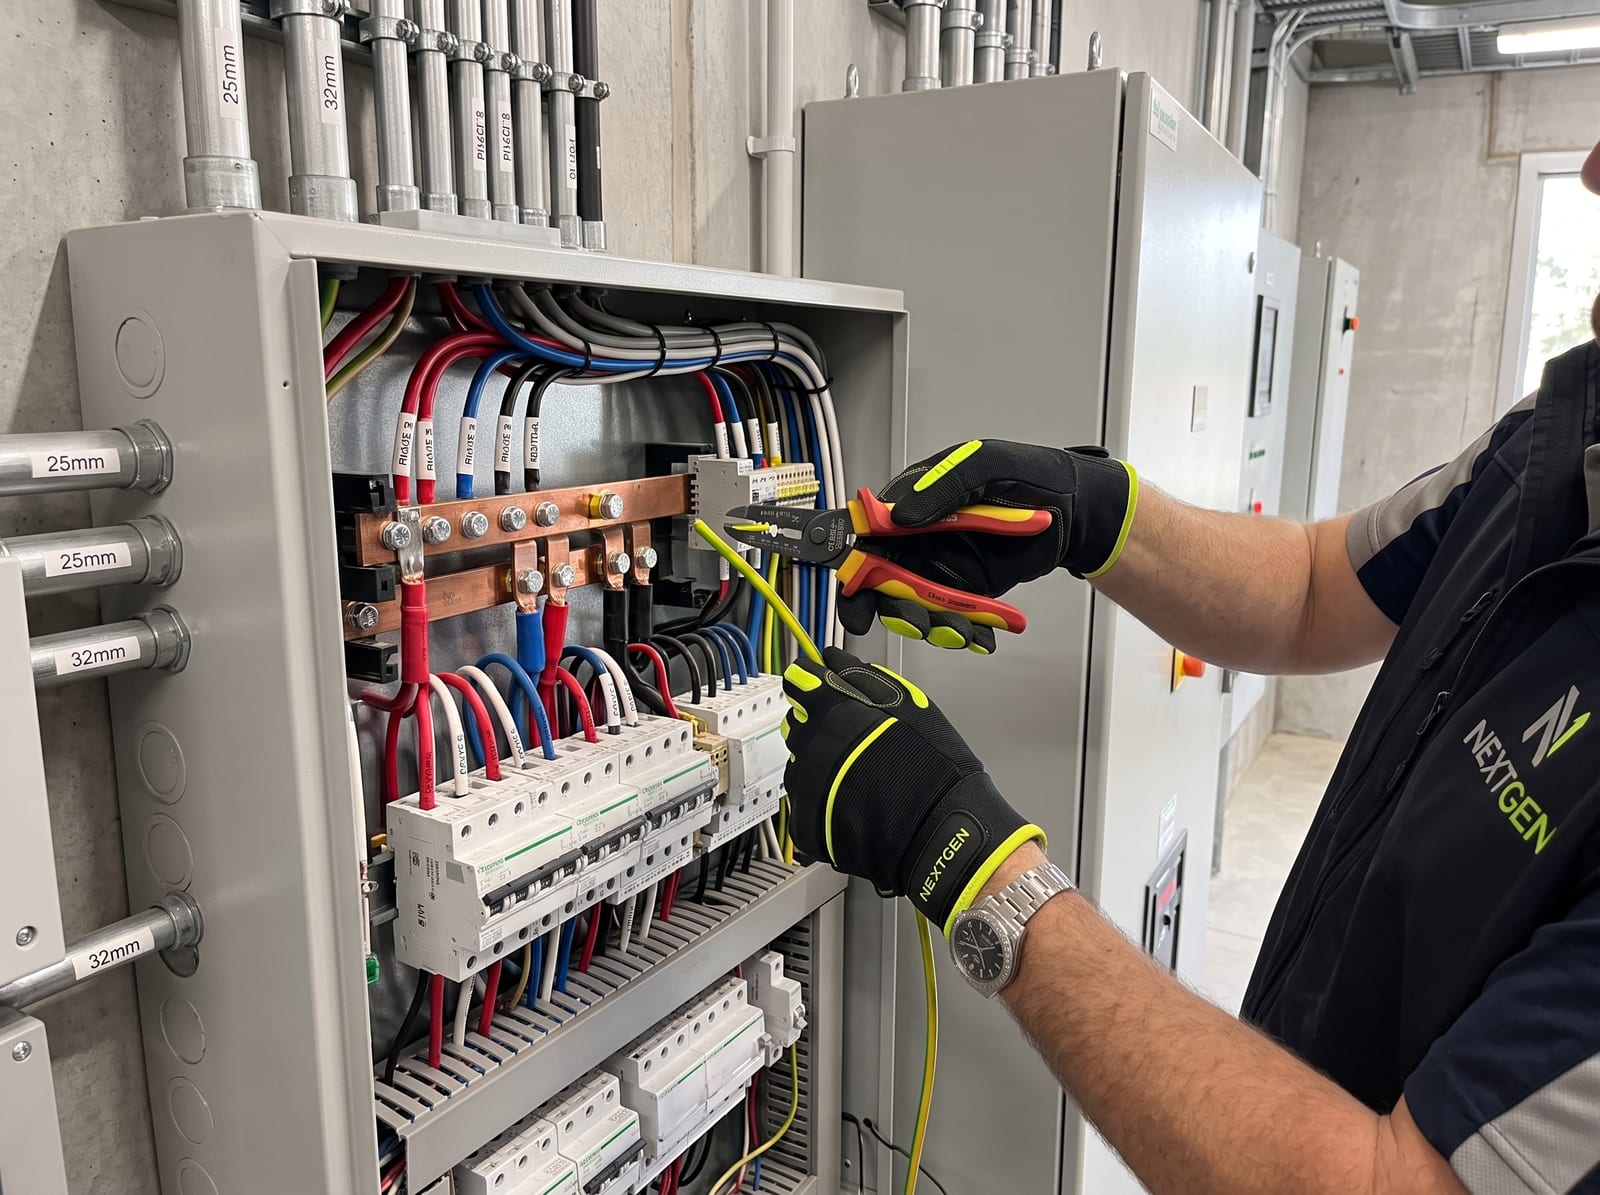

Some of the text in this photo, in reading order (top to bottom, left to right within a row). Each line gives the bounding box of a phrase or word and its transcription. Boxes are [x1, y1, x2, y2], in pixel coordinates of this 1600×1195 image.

[222, 45, 238, 105] 25mm
[323, 55, 338, 110] 32mm
[47, 455, 105, 473] 25mm
[60, 551, 117, 570] 25mm
[71, 645, 126, 667] 32mm
[1463, 719, 1558, 855] NEXTGEN
[919, 827, 971, 902] NEXTGEN
[89, 939, 141, 969] 32mm
